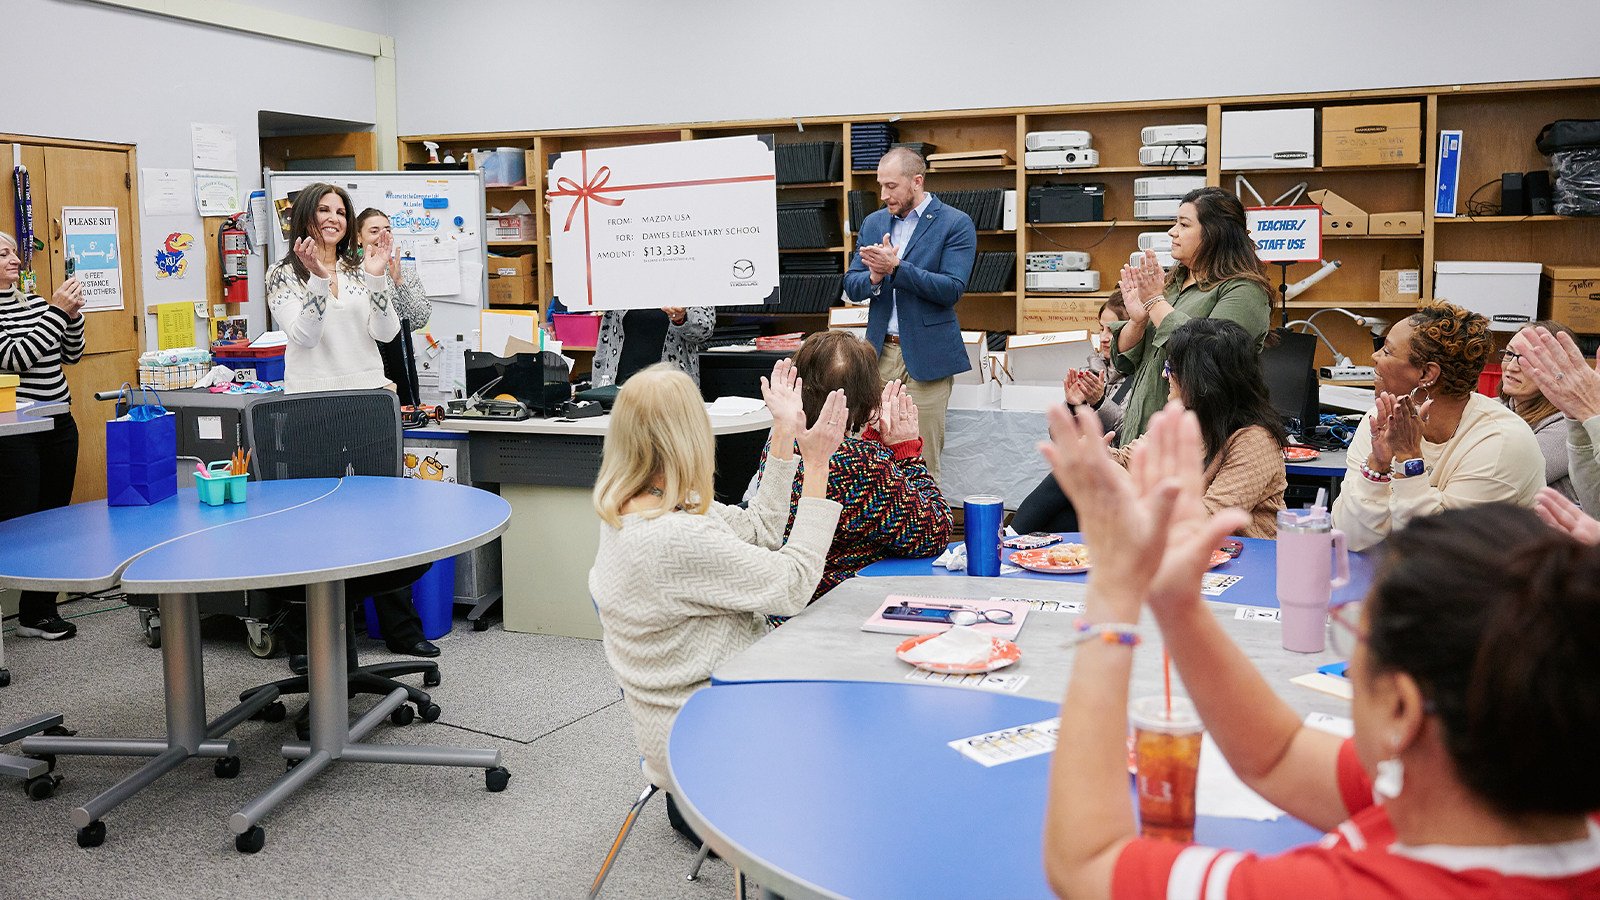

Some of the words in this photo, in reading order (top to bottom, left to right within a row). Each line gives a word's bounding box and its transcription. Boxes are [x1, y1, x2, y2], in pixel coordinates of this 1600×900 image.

[68, 217, 98, 226] PLEASE
[99, 217, 112, 226] SIT
[391, 216, 440, 229] TECHNOLOGY
[607, 218, 633, 226] FROM:
[642, 215, 672, 223] MAZDA
[674, 213, 691, 222] USA
[1257, 219, 1307, 232] TEACHER/
[616, 234, 634, 242] FOR:
[642, 232, 670, 241] DAWES
[672, 228, 723, 239] ELEMENTARY
[725, 226, 761, 236] SCHOOL
[1257, 239, 1287, 250] STAFF
[1287, 238, 1307, 250] USE
[597, 250, 635, 260] AMOUNT:
[643, 244, 687, 258] $13,333
[89, 271, 104, 279] FEET
[93, 287, 116, 296] OTHERS
